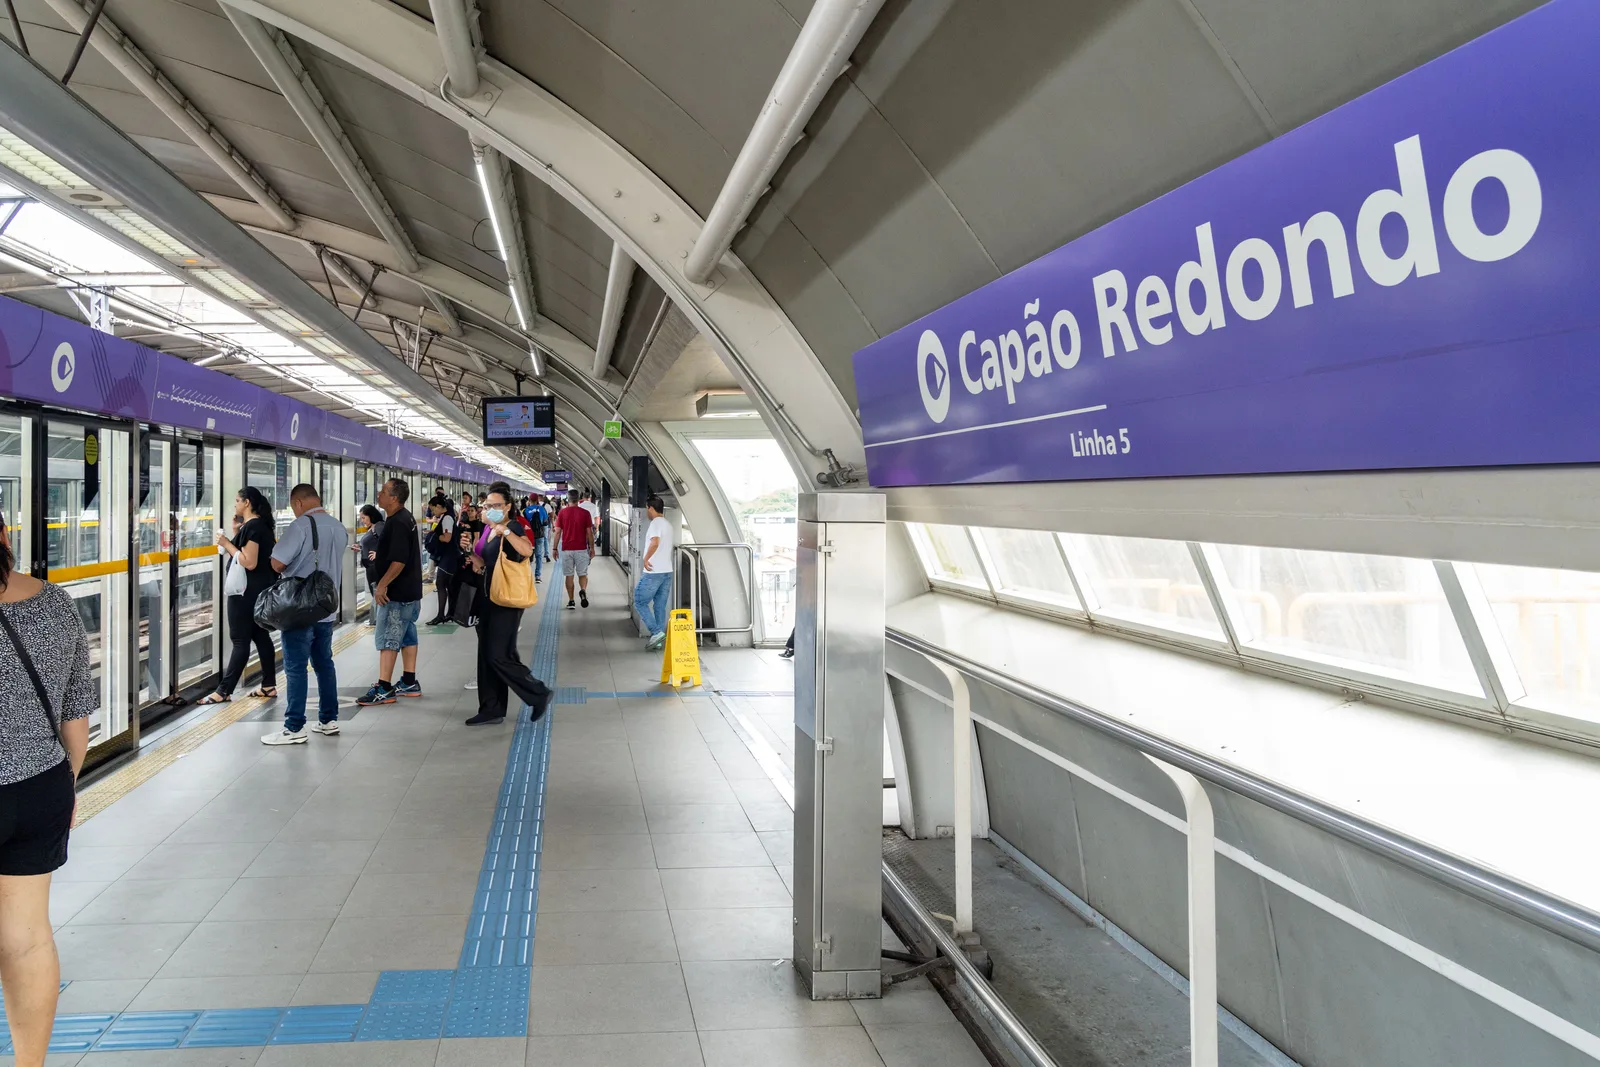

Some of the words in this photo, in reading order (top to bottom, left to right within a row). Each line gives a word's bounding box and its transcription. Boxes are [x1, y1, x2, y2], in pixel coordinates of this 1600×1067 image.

[958, 298, 1081, 405] Capão
[1092, 134, 1542, 358] Redondo
[1070, 429, 1118, 457] Linha
[1119, 428, 1131, 454] 5
[673, 624, 693, 632] CUIDADO
